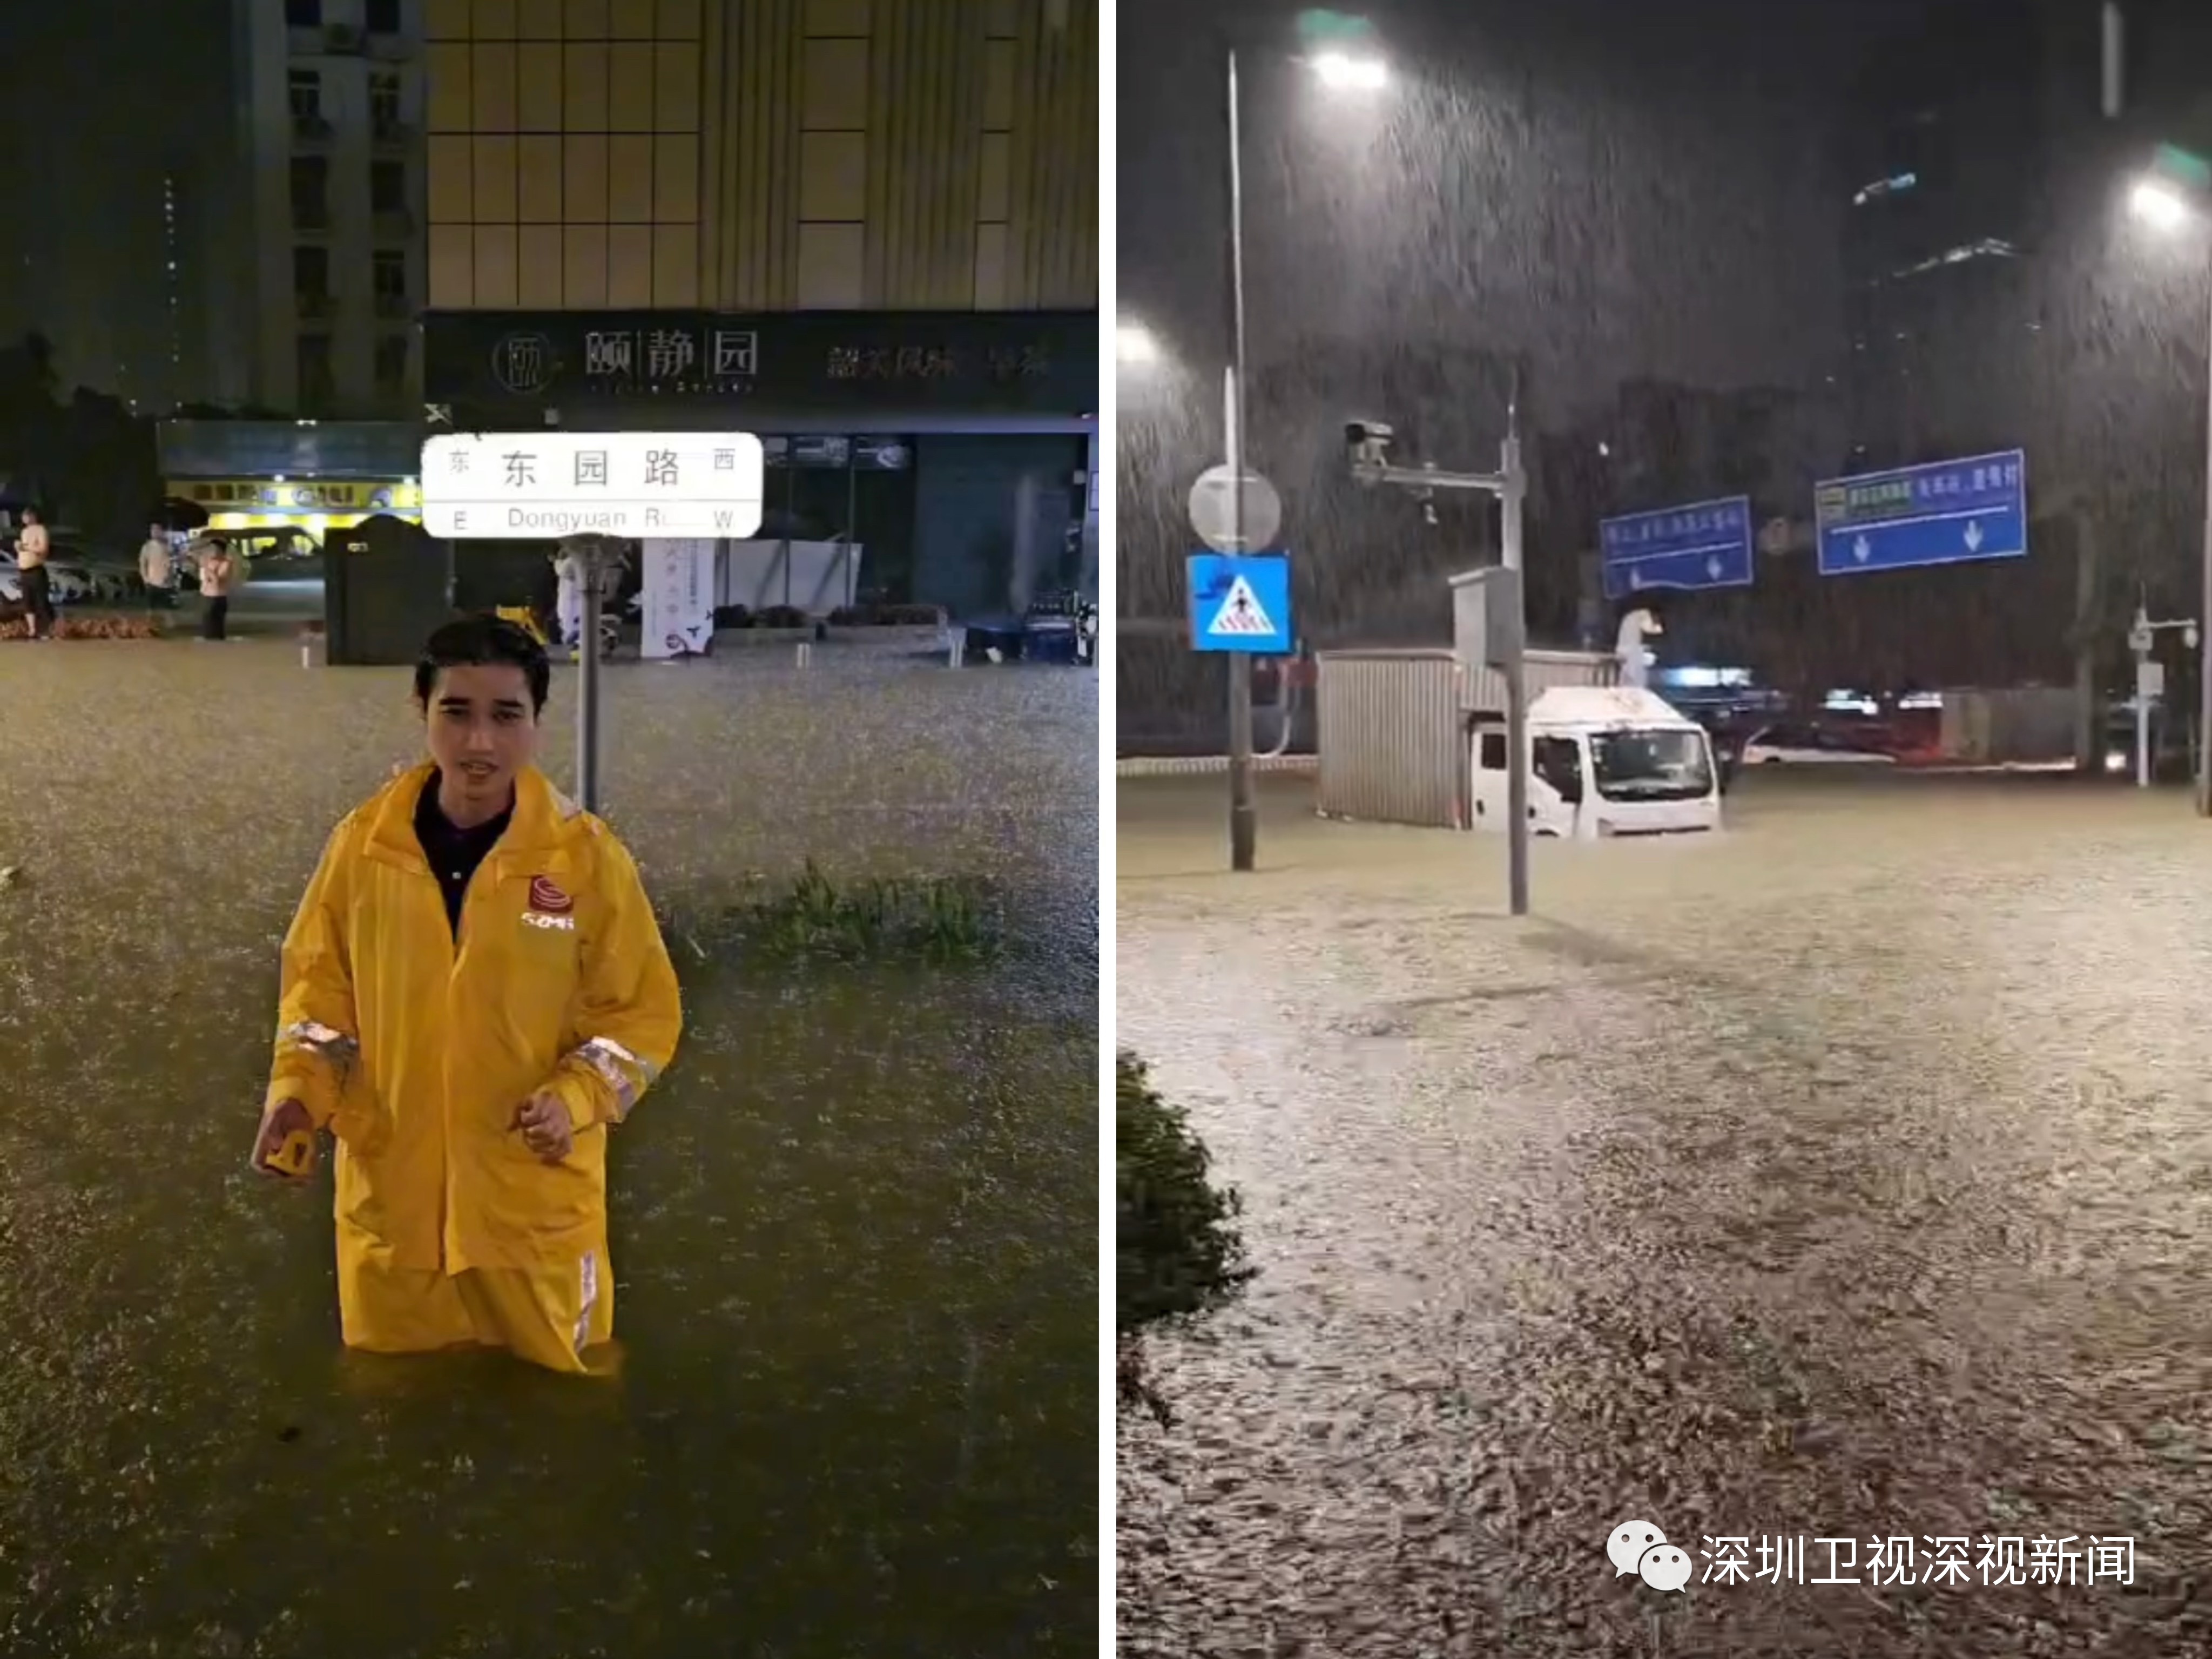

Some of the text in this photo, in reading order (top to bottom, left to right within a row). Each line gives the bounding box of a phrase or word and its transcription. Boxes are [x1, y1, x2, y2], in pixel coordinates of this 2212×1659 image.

[585, 329, 757, 376] 颐静园
[449, 448, 735, 488] 东 东园路 西
[454, 510, 467, 530] E
[508, 507, 626, 532] Dongyuan
[713, 510, 734, 529] W
